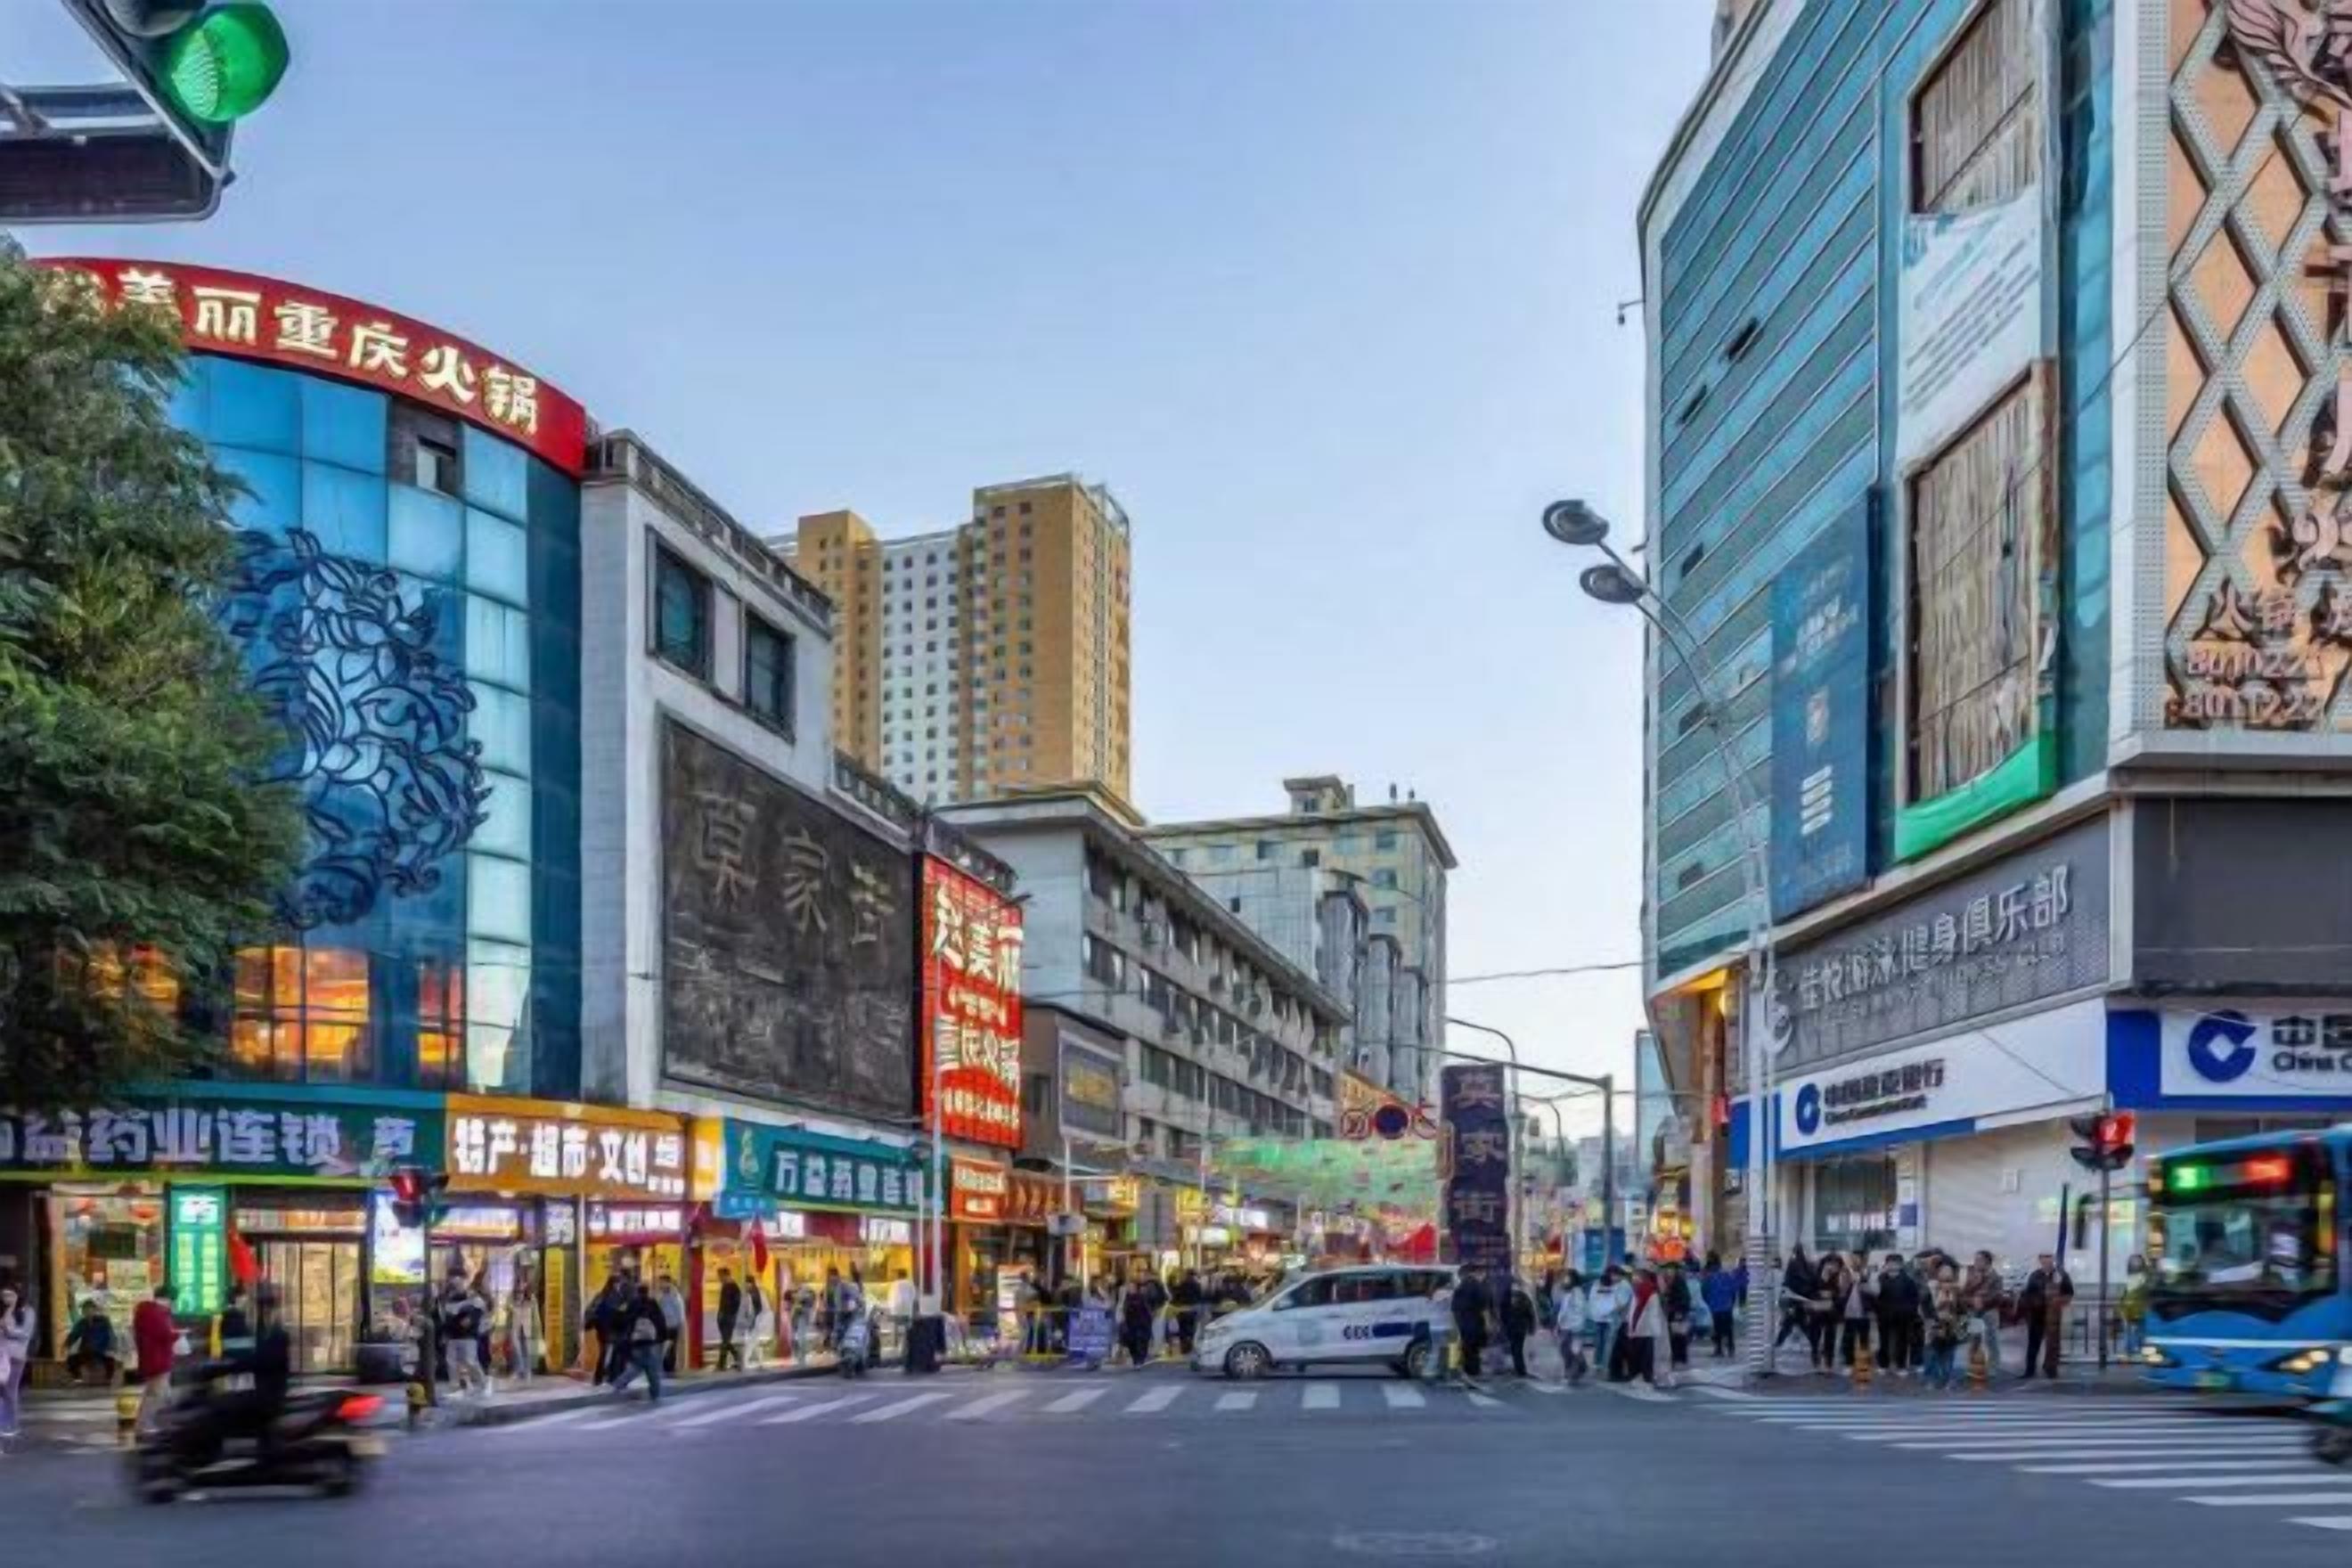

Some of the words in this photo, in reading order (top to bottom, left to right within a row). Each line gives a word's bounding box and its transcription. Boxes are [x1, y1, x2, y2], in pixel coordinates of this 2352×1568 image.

[46, 266, 539, 434] 美丽重庆火锅
[0, 1105, 341, 1164] 益药业连锁
